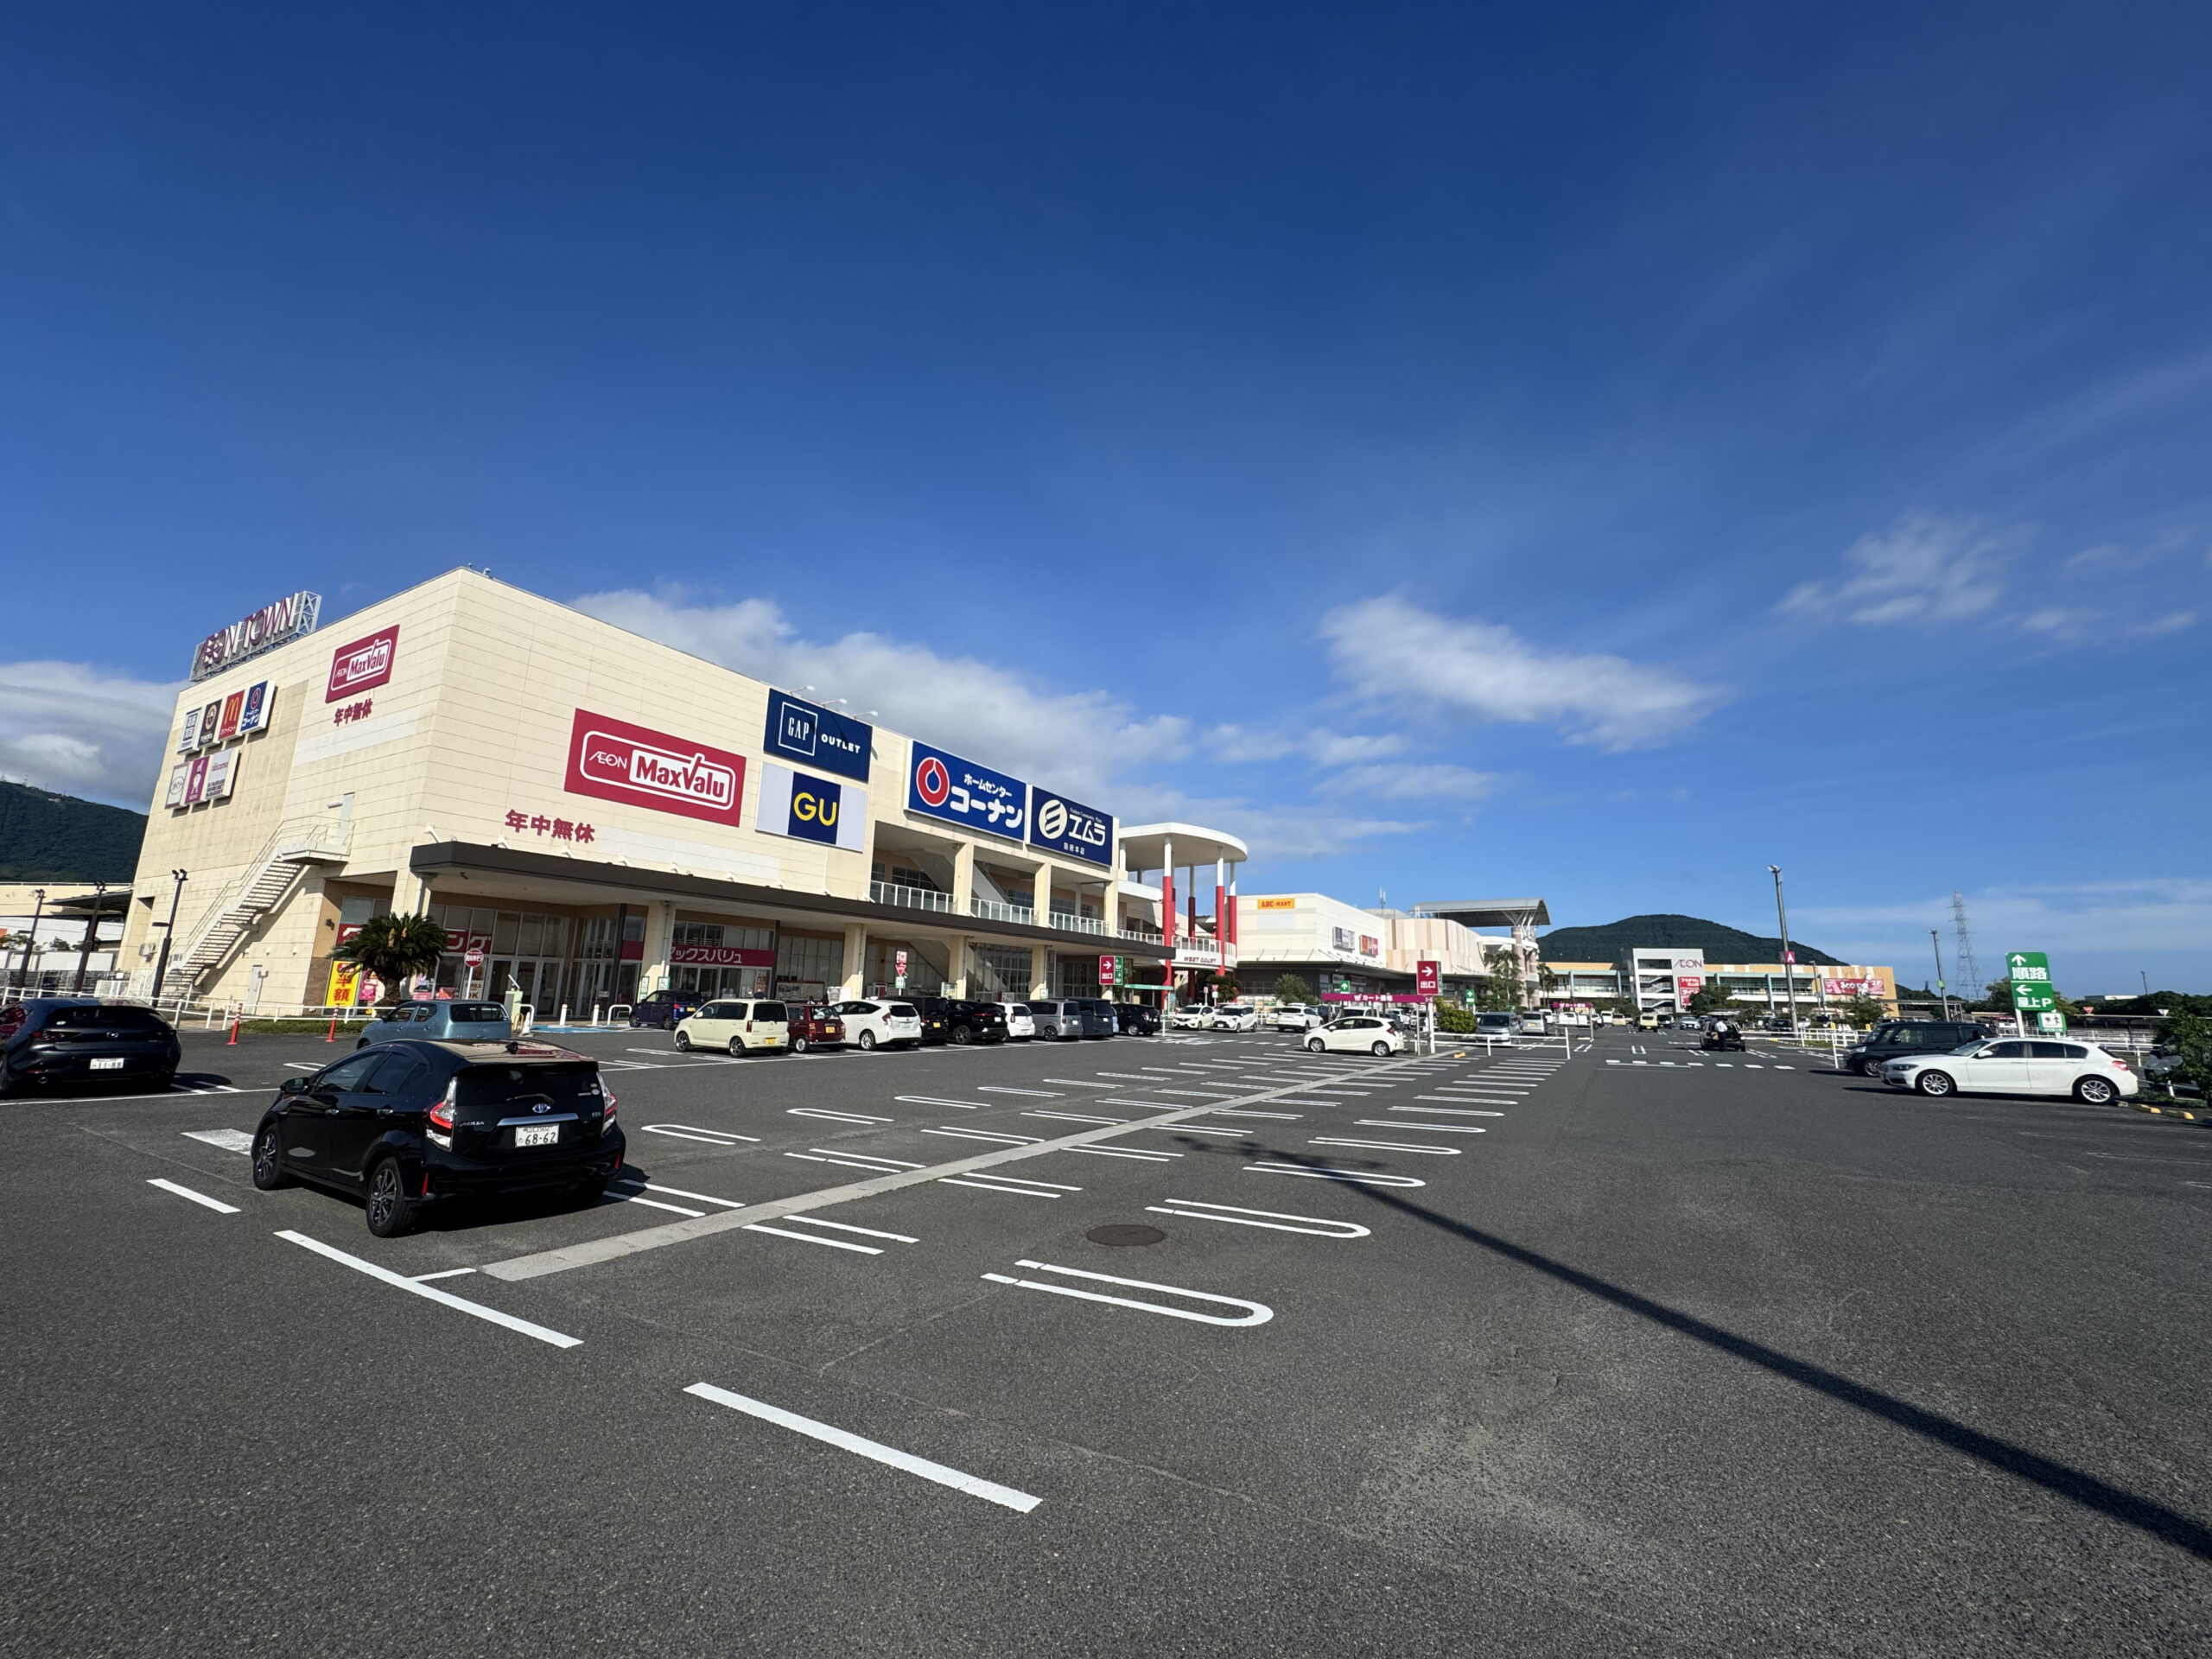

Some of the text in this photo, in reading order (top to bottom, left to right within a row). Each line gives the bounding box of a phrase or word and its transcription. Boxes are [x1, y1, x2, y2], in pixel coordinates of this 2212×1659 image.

[245, 593, 299, 648] TOWN
[349, 640, 385, 677] MaxValu
[334, 698, 373, 727] 年中無休
[787, 716, 861, 753] GAP OUTLET
[588, 751, 726, 798] AEON MaxValu
[963, 773, 1012, 798] ホームセンター
[793, 791, 837, 826] GU
[950, 785, 1023, 829] コーナン
[505, 809, 595, 843] 年中無休
[1068, 813, 1106, 846] エムラ
[1674, 959, 1702, 968] AEON
[1787, 952, 1795, 963] A
[2012, 966, 2047, 980] 順路
[524, 1132, 556, 1145] 68-62
